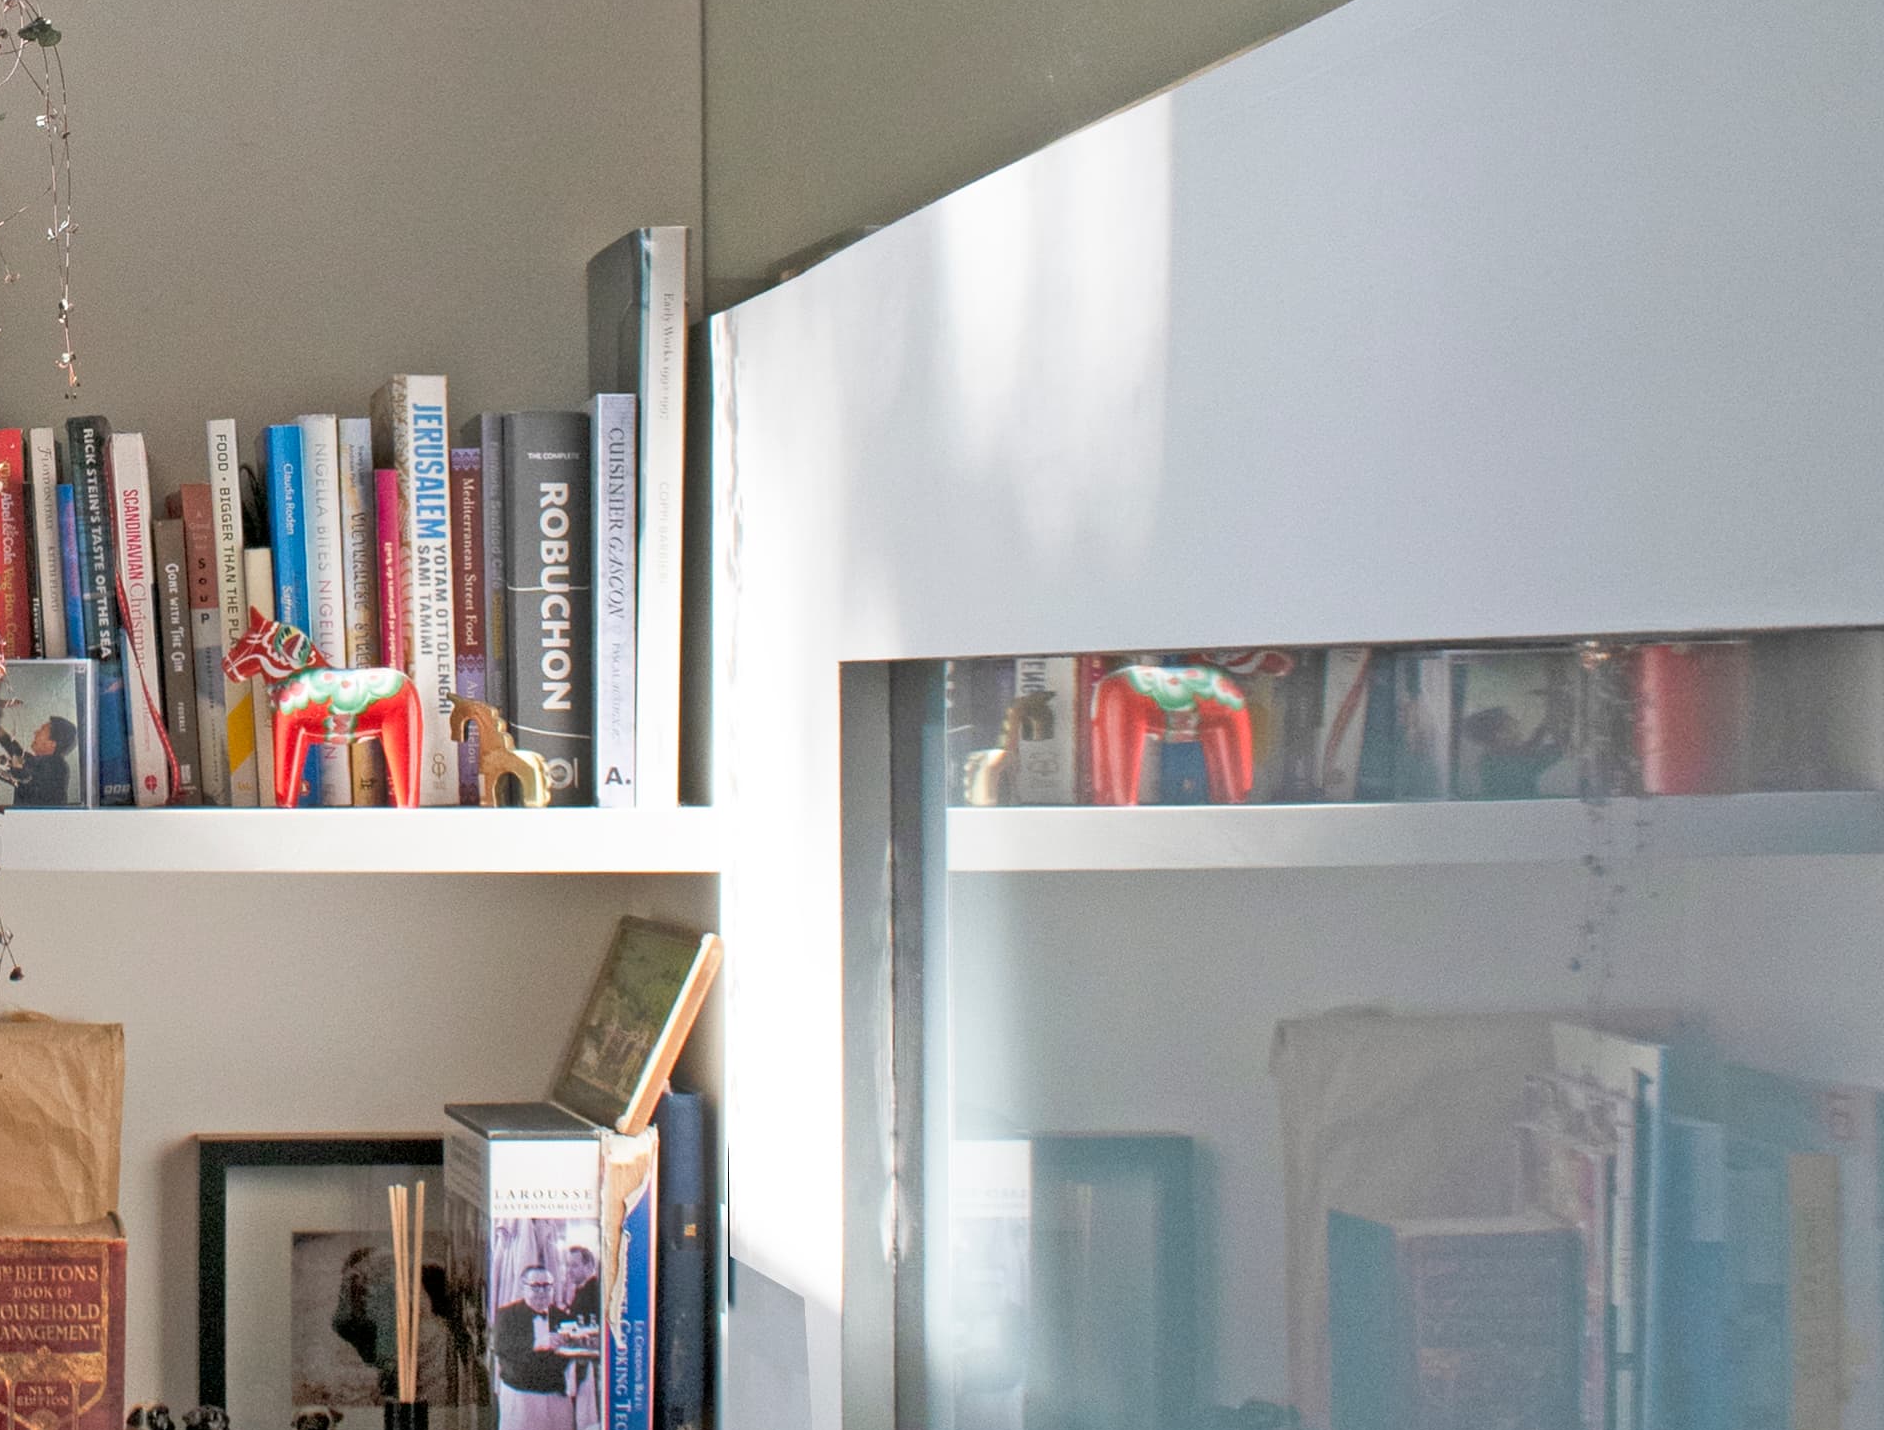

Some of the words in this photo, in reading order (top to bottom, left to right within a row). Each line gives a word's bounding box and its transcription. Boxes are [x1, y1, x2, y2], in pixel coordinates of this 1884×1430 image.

[83, 427, 97, 465] RICK
[216, 433, 229, 471] FOOD
[527, 452, 543, 460] THE
[544, 452, 581, 460] COMPLETE
[38, 447, 53, 484] FLOYD
[282, 463, 295, 501] Claudia
[315, 443, 329, 516] NIGELLA
[412, 402, 448, 539] JERUSALEM
[607, 426, 625, 532] CUISINIER
[0, 492, 14, 523] Abel
[43, 486, 53, 501] ON
[85, 467, 102, 523] STEIN'S
[219, 487, 233, 541] BIGGER
[284, 502, 297, 535] Roden
[462, 477, 477, 571] Mediterranean
[490, 499, 502, 555] Seafood
[2, 537, 15, 565] Cole
[91, 525, 106, 571] TASTE
[122, 488, 145, 580] SCANDINAVIAN
[317, 525, 331, 571] BITES
[223, 546, 237, 583] THAN
[351, 512, 372, 610] VIETNAMESE
[417, 544, 431, 588] SAMI
[433, 544, 448, 602] YOTAM
[606, 535, 626, 619] GASCON
[95, 574, 108, 595] OF
[226, 587, 239, 614] THE
[464, 573, 477, 613] Street
[539, 482, 571, 710] ROBUCHON
[4, 593, 18, 621] Box
[97, 597, 110, 627] THE
[127, 582, 151, 669] Christmas
[319, 579, 335, 660] NIGELLA
[419, 593, 433, 656] TAMIMI
[99, 629, 113, 659] SEA
[227, 618, 240, 645] PLA
[465, 615, 478, 646] Food
[435, 607, 452, 715] OTTOLENGHI
[493, 1203, 594, 1214] GASTRONOMIQUE
[494, 1189, 594, 1200] LAROUSSE
[12, 1286, 54, 1299] BOOK
[57, 1286, 73, 1299] OF
[633, 1334, 645, 1382] CORDON
[16, 1396, 70, 1406] EDITION
[27, 1386, 59, 1396] NEW
